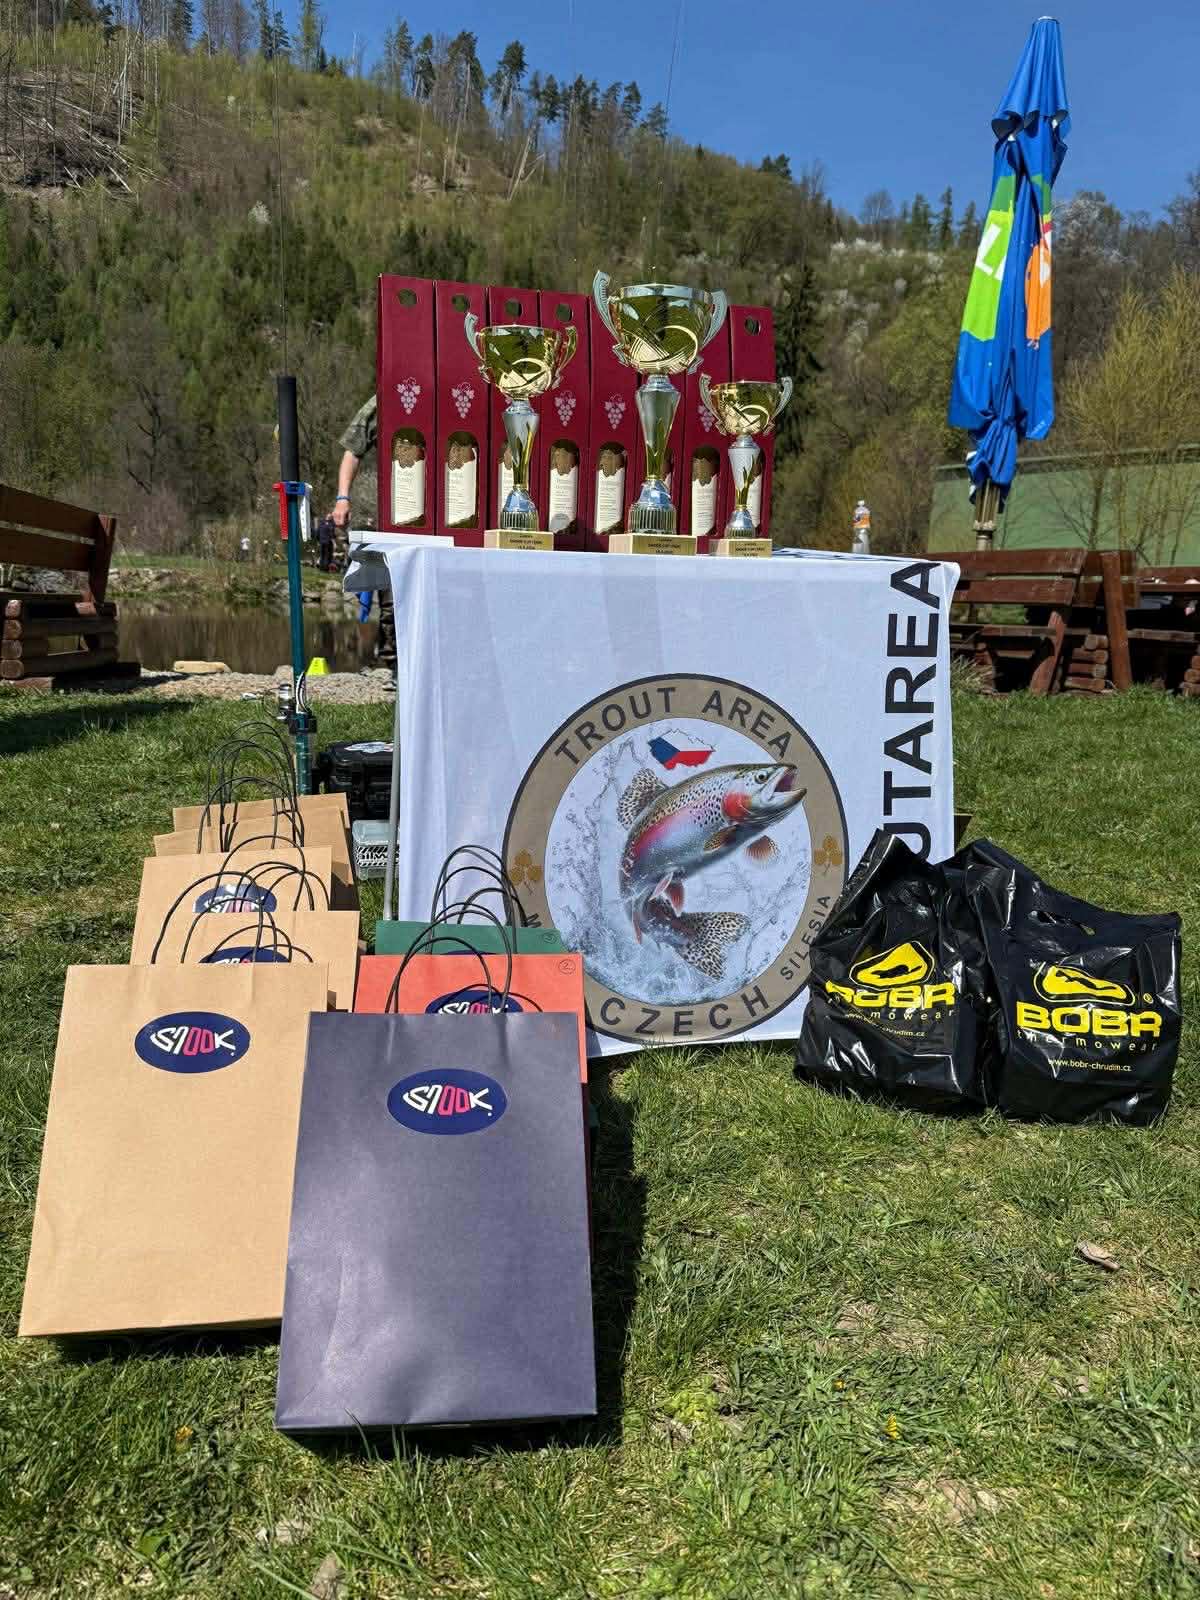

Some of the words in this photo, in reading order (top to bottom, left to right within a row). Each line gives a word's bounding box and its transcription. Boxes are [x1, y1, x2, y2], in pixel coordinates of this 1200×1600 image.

[555, 687, 676, 765] TROUT
[701, 690, 793, 758] AREA
[780, 895, 831, 980] SILESIA
[600, 985, 769, 1036] CZECH
[1016, 1001, 1162, 1037] BOBR
[1049, 1058, 1132, 1072] www.bobr-chrudim.cz
